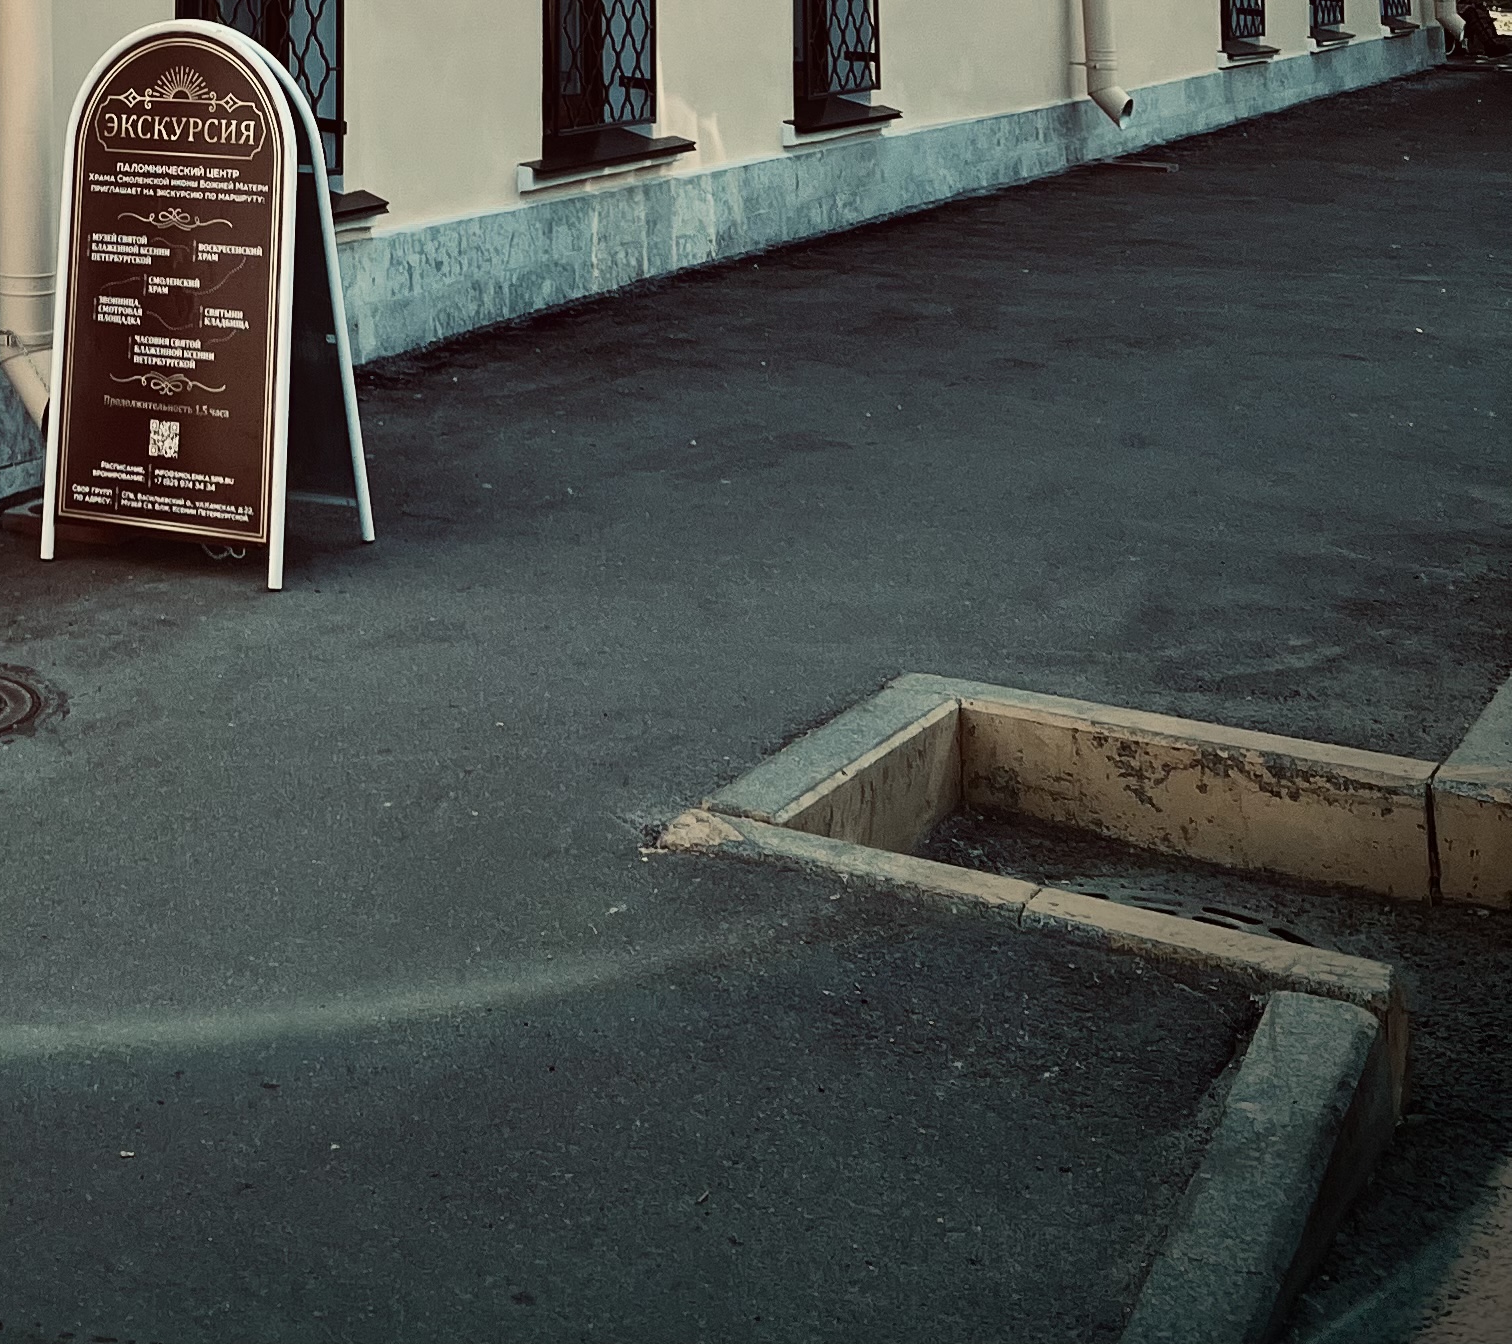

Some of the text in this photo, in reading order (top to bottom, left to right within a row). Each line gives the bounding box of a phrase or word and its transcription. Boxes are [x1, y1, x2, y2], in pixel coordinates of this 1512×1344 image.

[103, 113, 256, 145] ЭКСКУРСИЯ
[116, 162, 239, 179] ПАЛОМНИЧЕСКИЙ ЦЕНТР
[90, 184, 141, 196] ПРИГЛАШАЕТ
[143, 188, 155, 196] НА
[156, 188, 203, 200] ЭКСКУРСИЮ
[205, 192, 217, 201] ПО
[92, 232, 148, 245] МУЗЕЙ СВЯТОЙ
[91, 243, 139, 254] БЛАЖЕННОЙ
[198, 243, 263, 256] ВОСКРЕСЕНСКИЙ
[91, 252, 152, 265] ПЕТЕРБУРГСКОЙ
[197, 252, 219, 262] ХРАМ
[148, 275, 200, 289] СМОЛЕНСКИЙ
[148, 285, 169, 294] ХРАМ
[98, 305, 143, 317] СМОТРОВАЯ
[204, 308, 243, 319] СВЯТЫНИ
[97, 314, 141, 325] ПЛОЩАДКА
[204, 317, 250, 329] КЛАДБИЩА
[170, 338, 201, 349] СВЯТОЙ
[134, 344, 183, 357] БЛАЖЕННОЙ
[133, 355, 196, 369] ПЕТЕРБУРГСКОЙ
[104, 395, 193, 415] Продолжительность
[209, 408, 230, 418] часа
